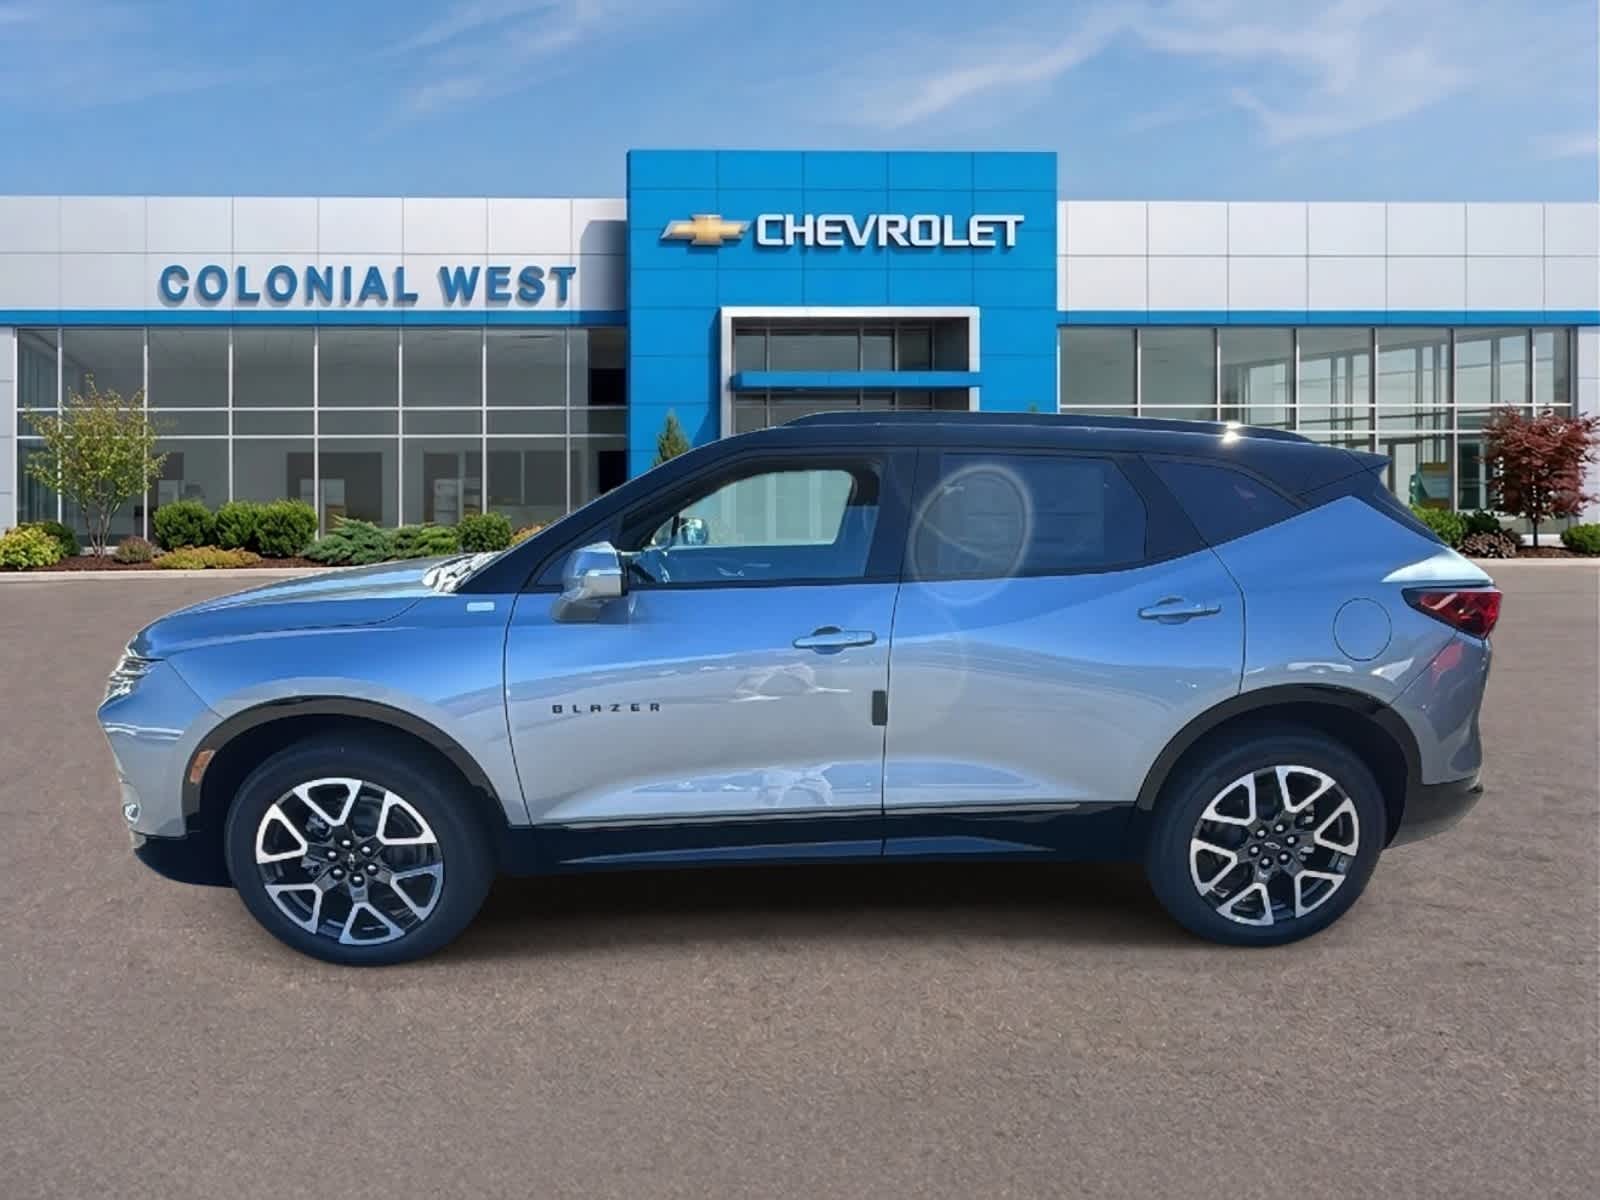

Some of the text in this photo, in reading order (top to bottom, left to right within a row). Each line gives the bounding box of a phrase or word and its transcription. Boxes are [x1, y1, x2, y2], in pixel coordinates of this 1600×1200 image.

[757, 214, 1024, 248] CHEVROLET
[160, 265, 576, 305] COLONIAL WEST
[551, 702, 661, 714] BLAZER
